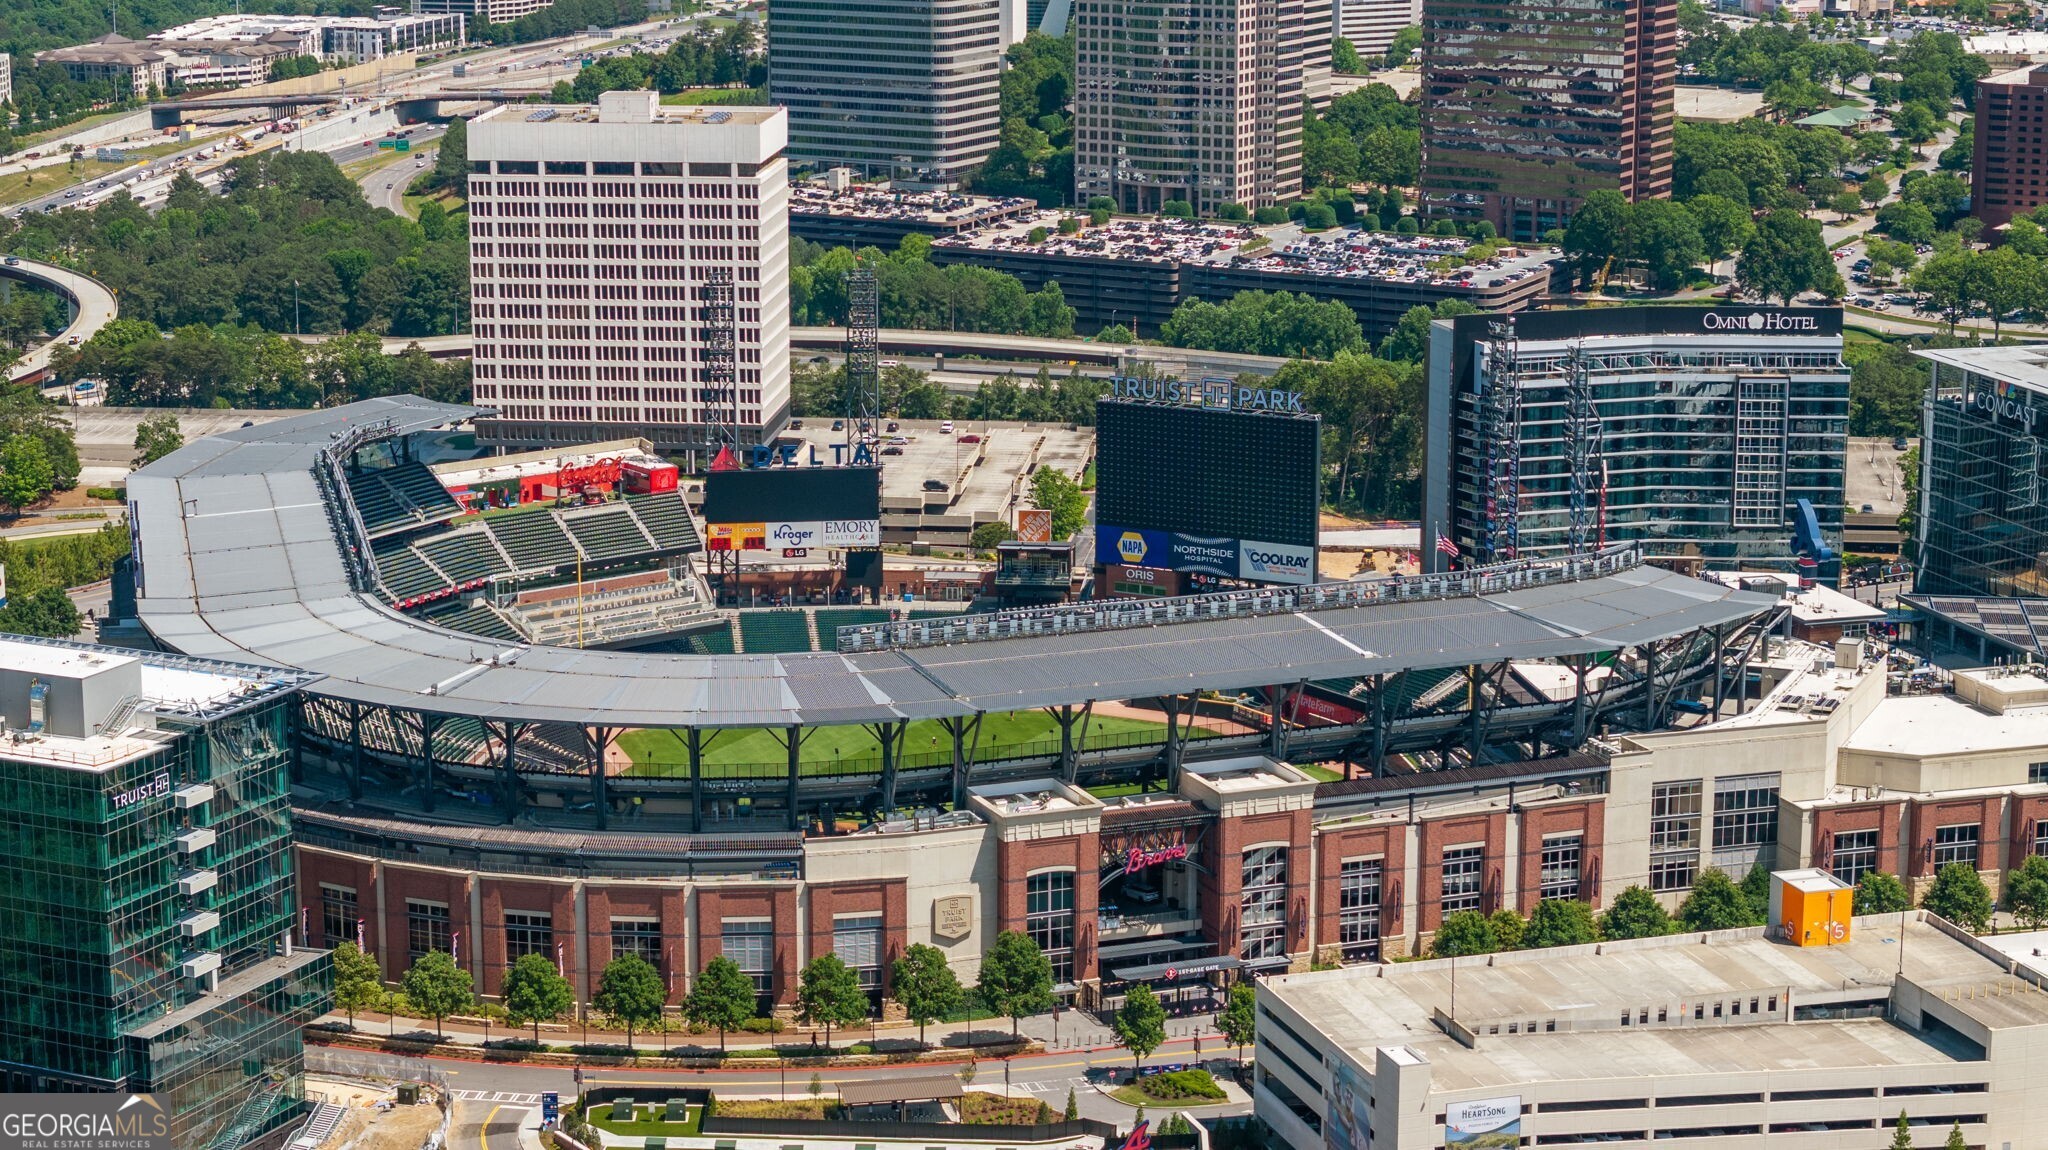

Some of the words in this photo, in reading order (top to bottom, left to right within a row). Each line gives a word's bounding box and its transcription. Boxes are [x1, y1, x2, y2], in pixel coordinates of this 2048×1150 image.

[1703, 312, 1747, 329] OMNI
[1765, 313, 1819, 330] HOTEL
[1109, 376, 1198, 403] TRUIST
[1238, 387, 1303, 412] PARK
[1976, 392, 2038, 426] COMCAST
[753, 442, 874, 467] DELTA
[825, 520, 877, 534] EMORY
[774, 524, 814, 546] Kroger
[825, 533, 876, 541] HEALTHCARE
[1122, 540, 1143, 555] NAPA
[1173, 544, 1234, 558] NORTHSIDE
[1184, 554, 1224, 564] HOSPITAL
[1250, 551, 1310, 568] COOLRAY
[1126, 569, 1154, 581] ORIS
[1207, 576, 1216, 584] LG
[113, 782, 154, 810] TRUIST
[1126, 844, 1187, 874] Braves
[942, 908, 966, 916] TRUIST
[1787, 921, 1794, 936] 5
[1834, 924, 1844, 939] 5
[1462, 1107, 1506, 1119] HEARTSONG
